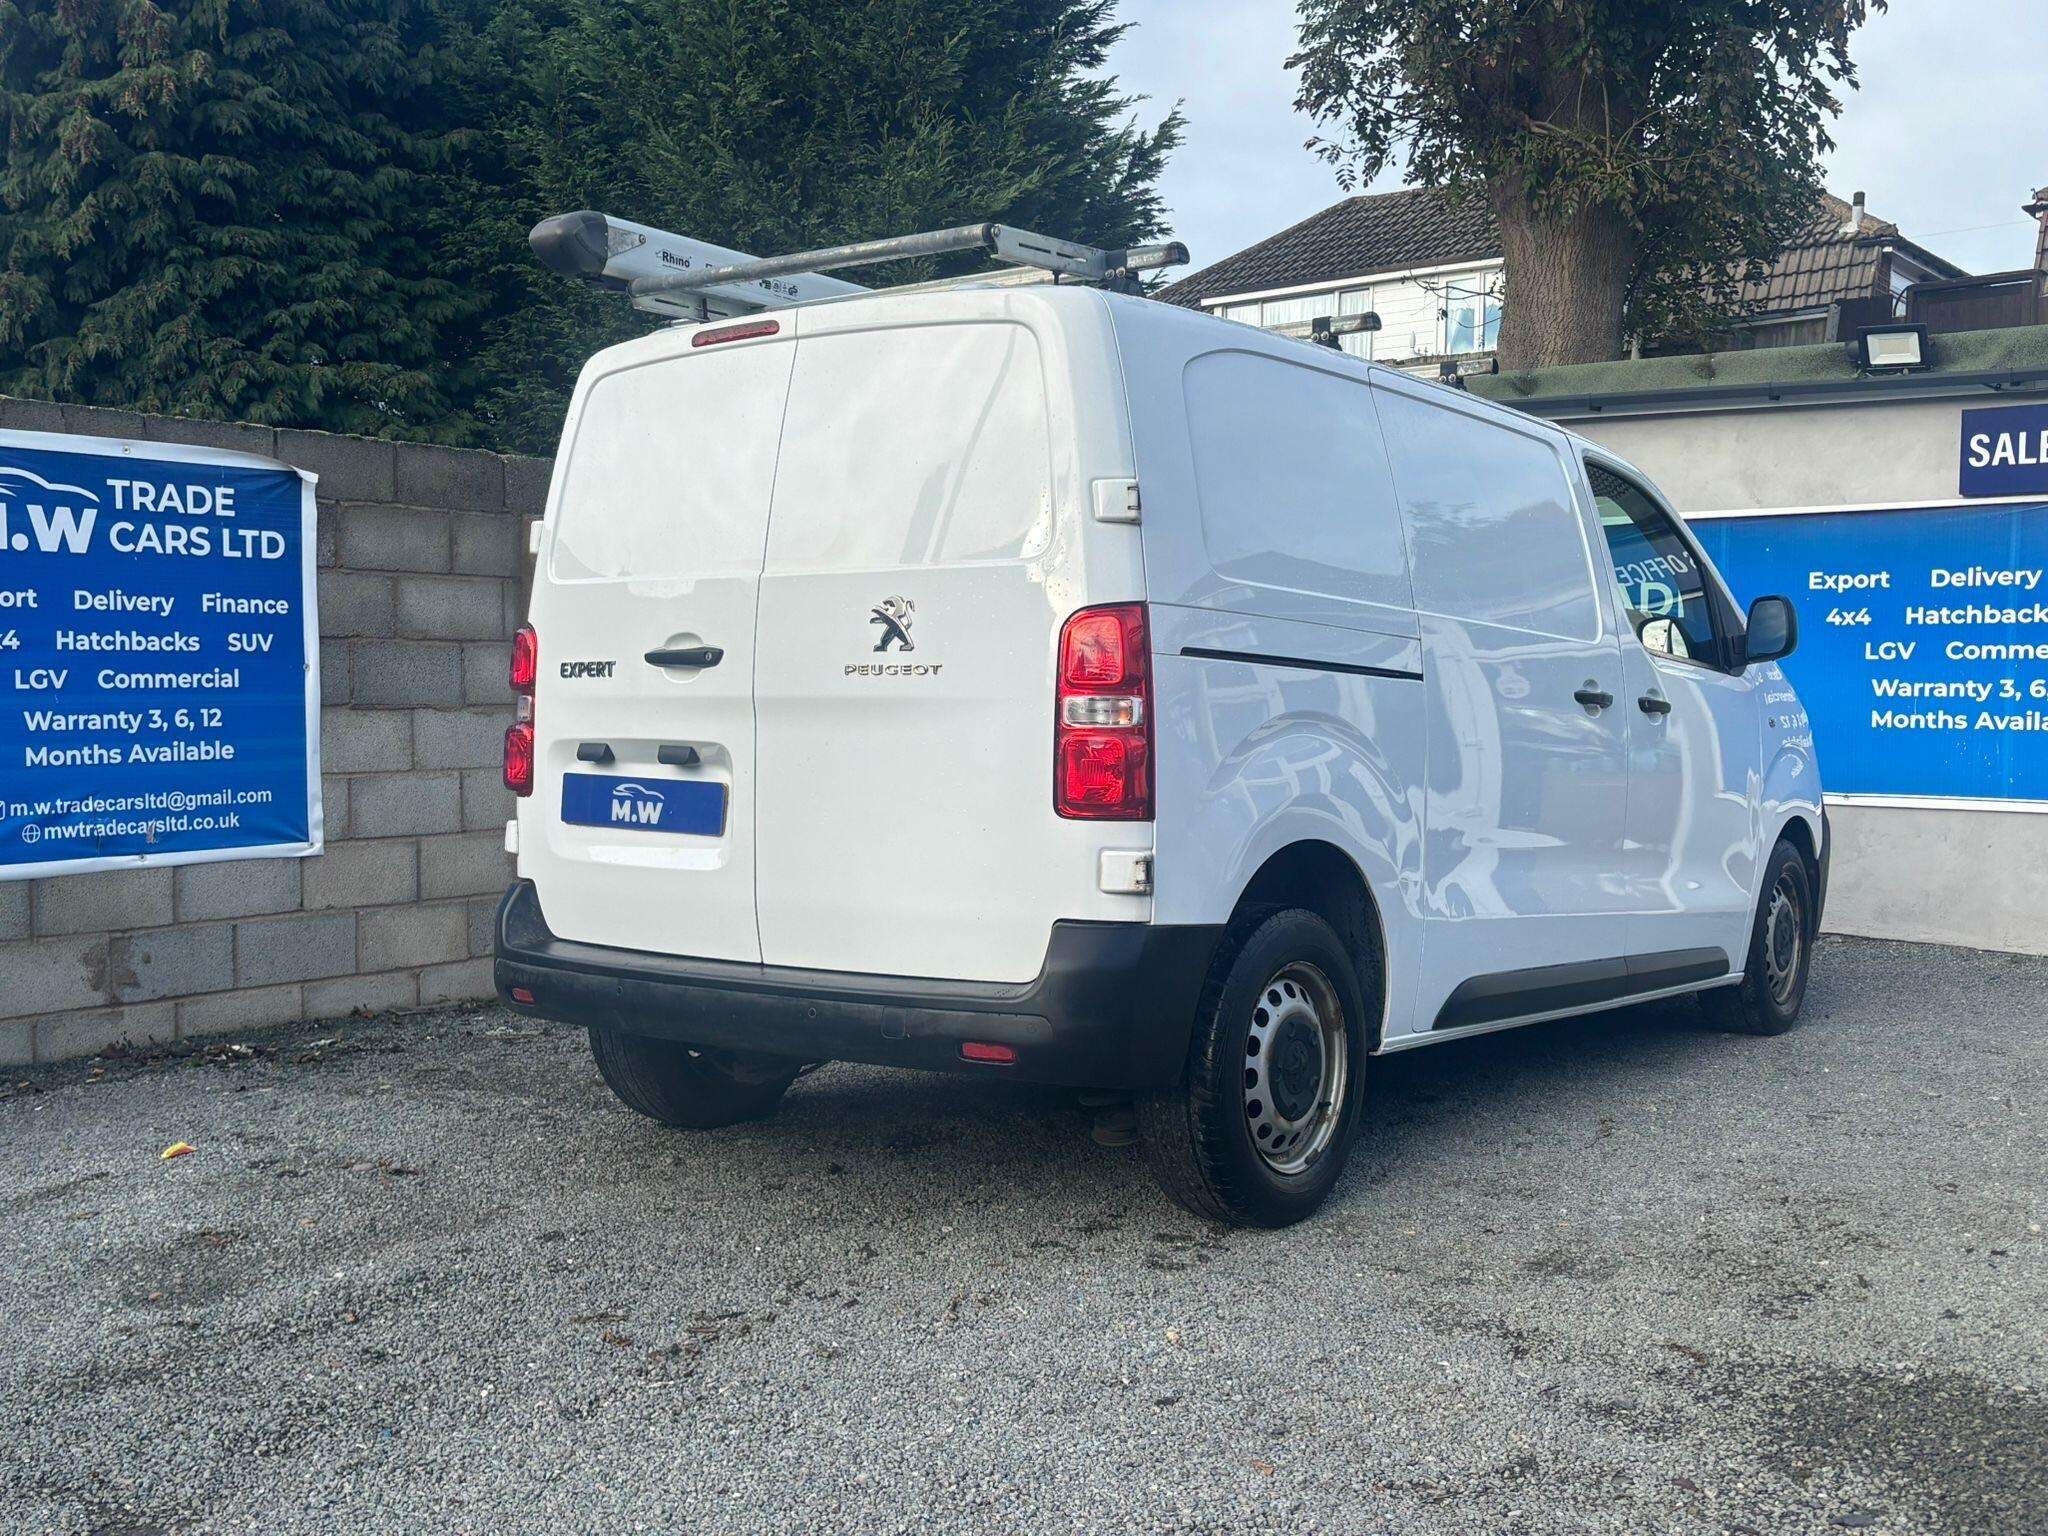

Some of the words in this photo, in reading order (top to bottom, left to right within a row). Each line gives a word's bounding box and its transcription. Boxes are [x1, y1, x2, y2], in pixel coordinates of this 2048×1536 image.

[662, 250, 691, 269] Rhino
[106, 478, 236, 517] TRADE
[0, 503, 98, 553] .W
[109, 521, 211, 557] CARS
[222, 528, 286, 560] LTD
[1808, 571, 1890, 593] Export
[1931, 566, 2043, 590] Delivery
[74, 588, 175, 617] Delivery
[202, 592, 289, 615] Finance
[1825, 607, 1872, 626] 4x4
[1905, 603, 2048, 625] Hatchback
[0, 629, 21, 650] 4
[56, 630, 200, 652] Hatchbacks
[228, 633, 274, 652] SUV
[1865, 641, 1916, 660] LGV
[1945, 641, 2048, 660] Comme
[14, 668, 68, 690] LGV
[98, 668, 240, 689] Commercial
[560, 661, 617, 679] EXPERT
[844, 663, 944, 677] PEUGEOT
[1872, 678, 1993, 702] Warranty
[1999, 679, 2022, 702] 3,
[2029, 679, 2048, 701] 6
[23, 708, 142, 734] Warranty
[148, 709, 168, 732] 3,
[174, 708, 195, 731] 6,
[200, 708, 223, 728] 12
[1871, 709, 1968, 730] Months
[25, 745, 122, 767] Months
[128, 739, 235, 764] Available
[9, 788, 272, 818] m.w.tradecarsltd@gmail.com
[611, 799, 664, 825] M.W
[44, 812, 240, 839] mwtradecarsltd.co.uk
